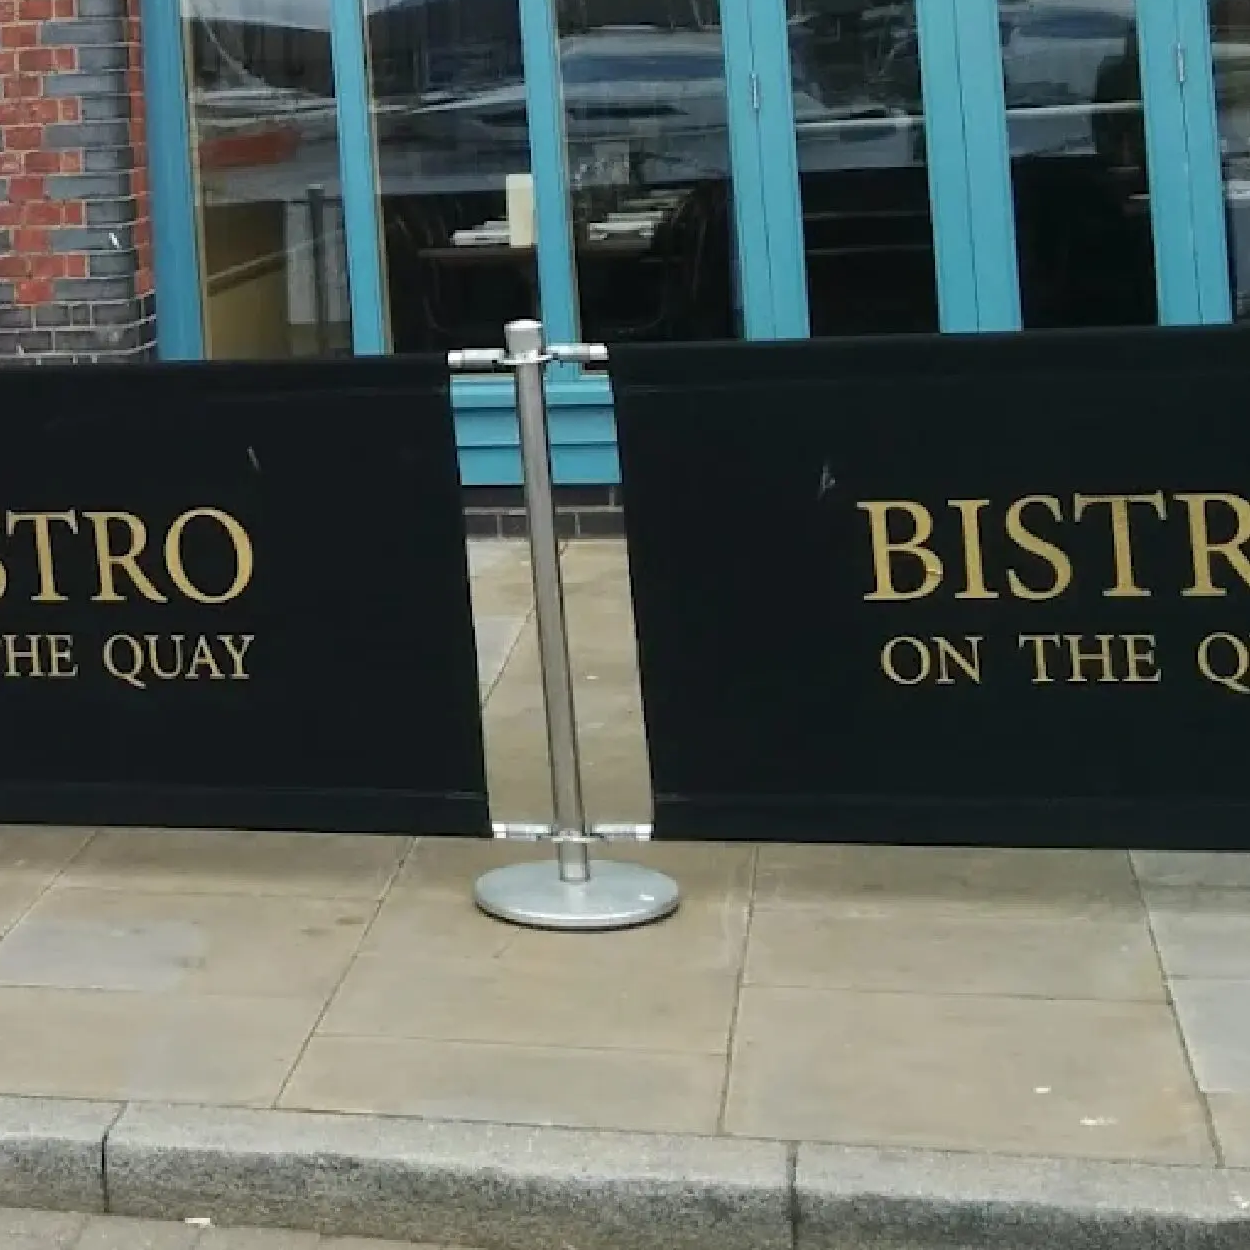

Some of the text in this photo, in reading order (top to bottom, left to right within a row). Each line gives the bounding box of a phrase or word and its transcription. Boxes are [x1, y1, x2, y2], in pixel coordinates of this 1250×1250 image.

[102, 634, 254, 689] QUAY
[881, 635, 983, 684] ON
[1019, 633, 1161, 683] THE
